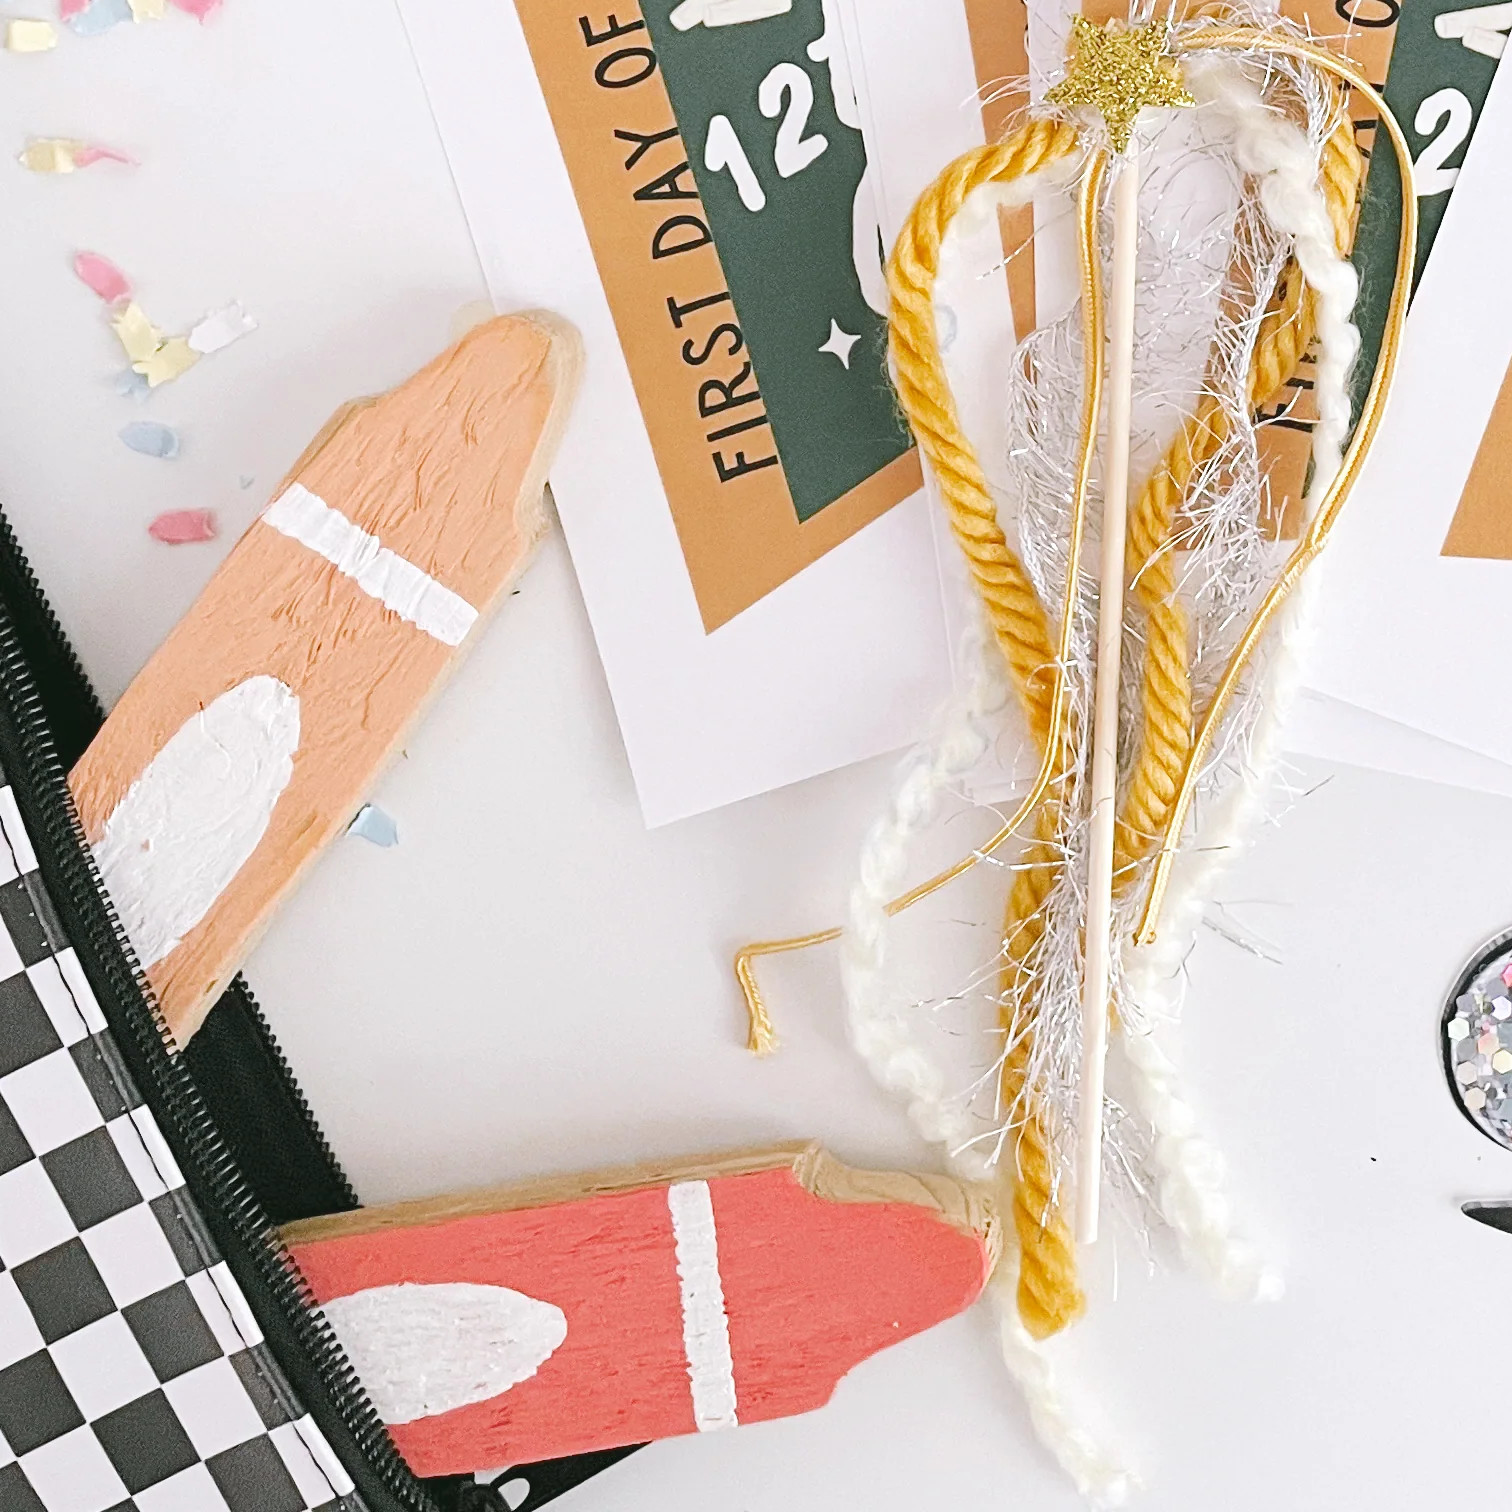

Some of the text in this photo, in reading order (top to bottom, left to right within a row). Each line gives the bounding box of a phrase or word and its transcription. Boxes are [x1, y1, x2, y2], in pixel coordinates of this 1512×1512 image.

[579, 15, 778, 484] FIRST DAY OF
